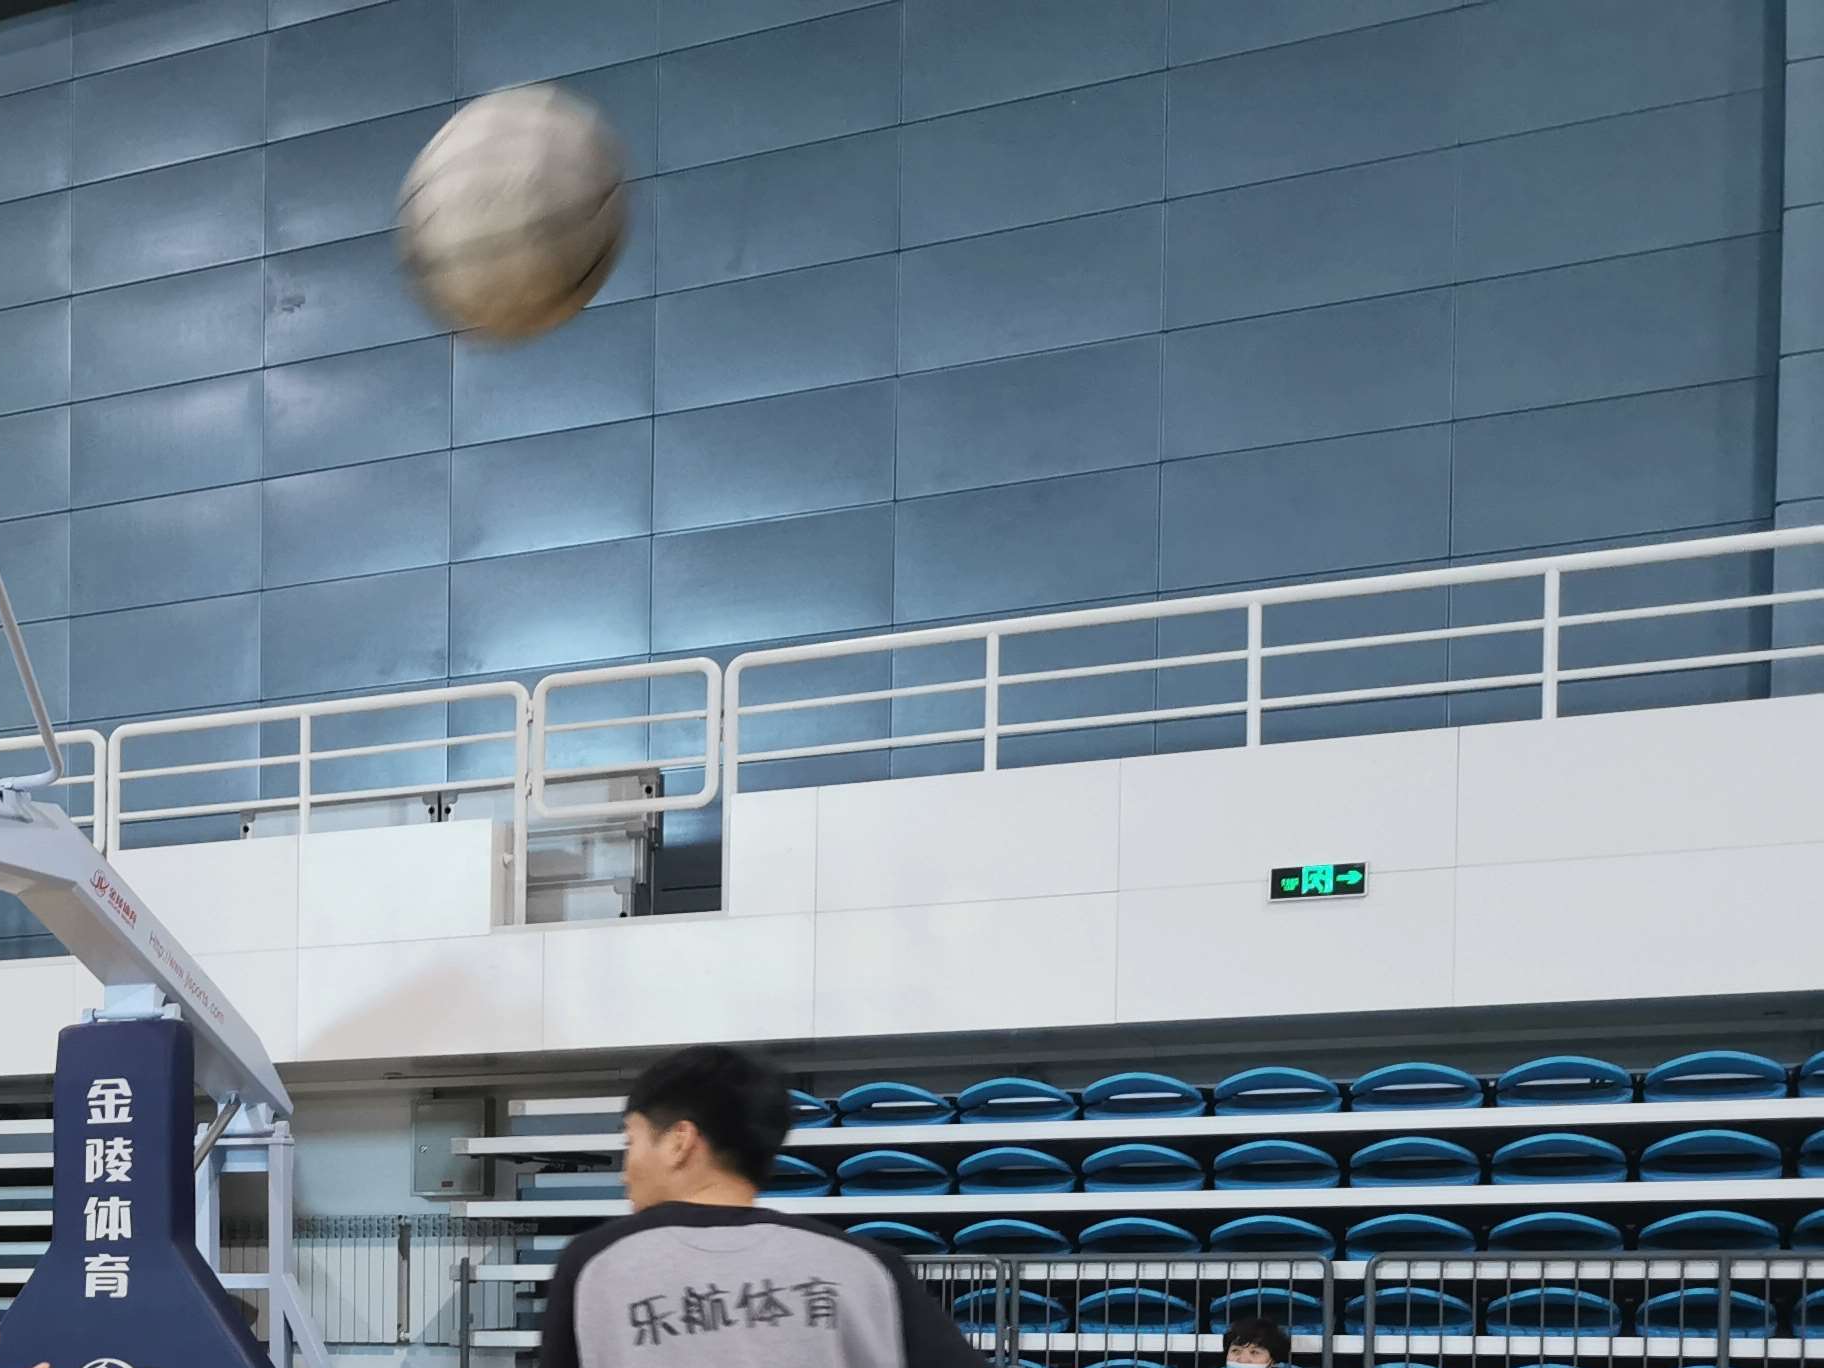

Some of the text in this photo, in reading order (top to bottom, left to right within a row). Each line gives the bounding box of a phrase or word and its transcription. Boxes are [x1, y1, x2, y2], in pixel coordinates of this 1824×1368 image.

[84, 1077, 133, 1298] 金陵体育
[628, 1276, 841, 1346] 乐航体育
